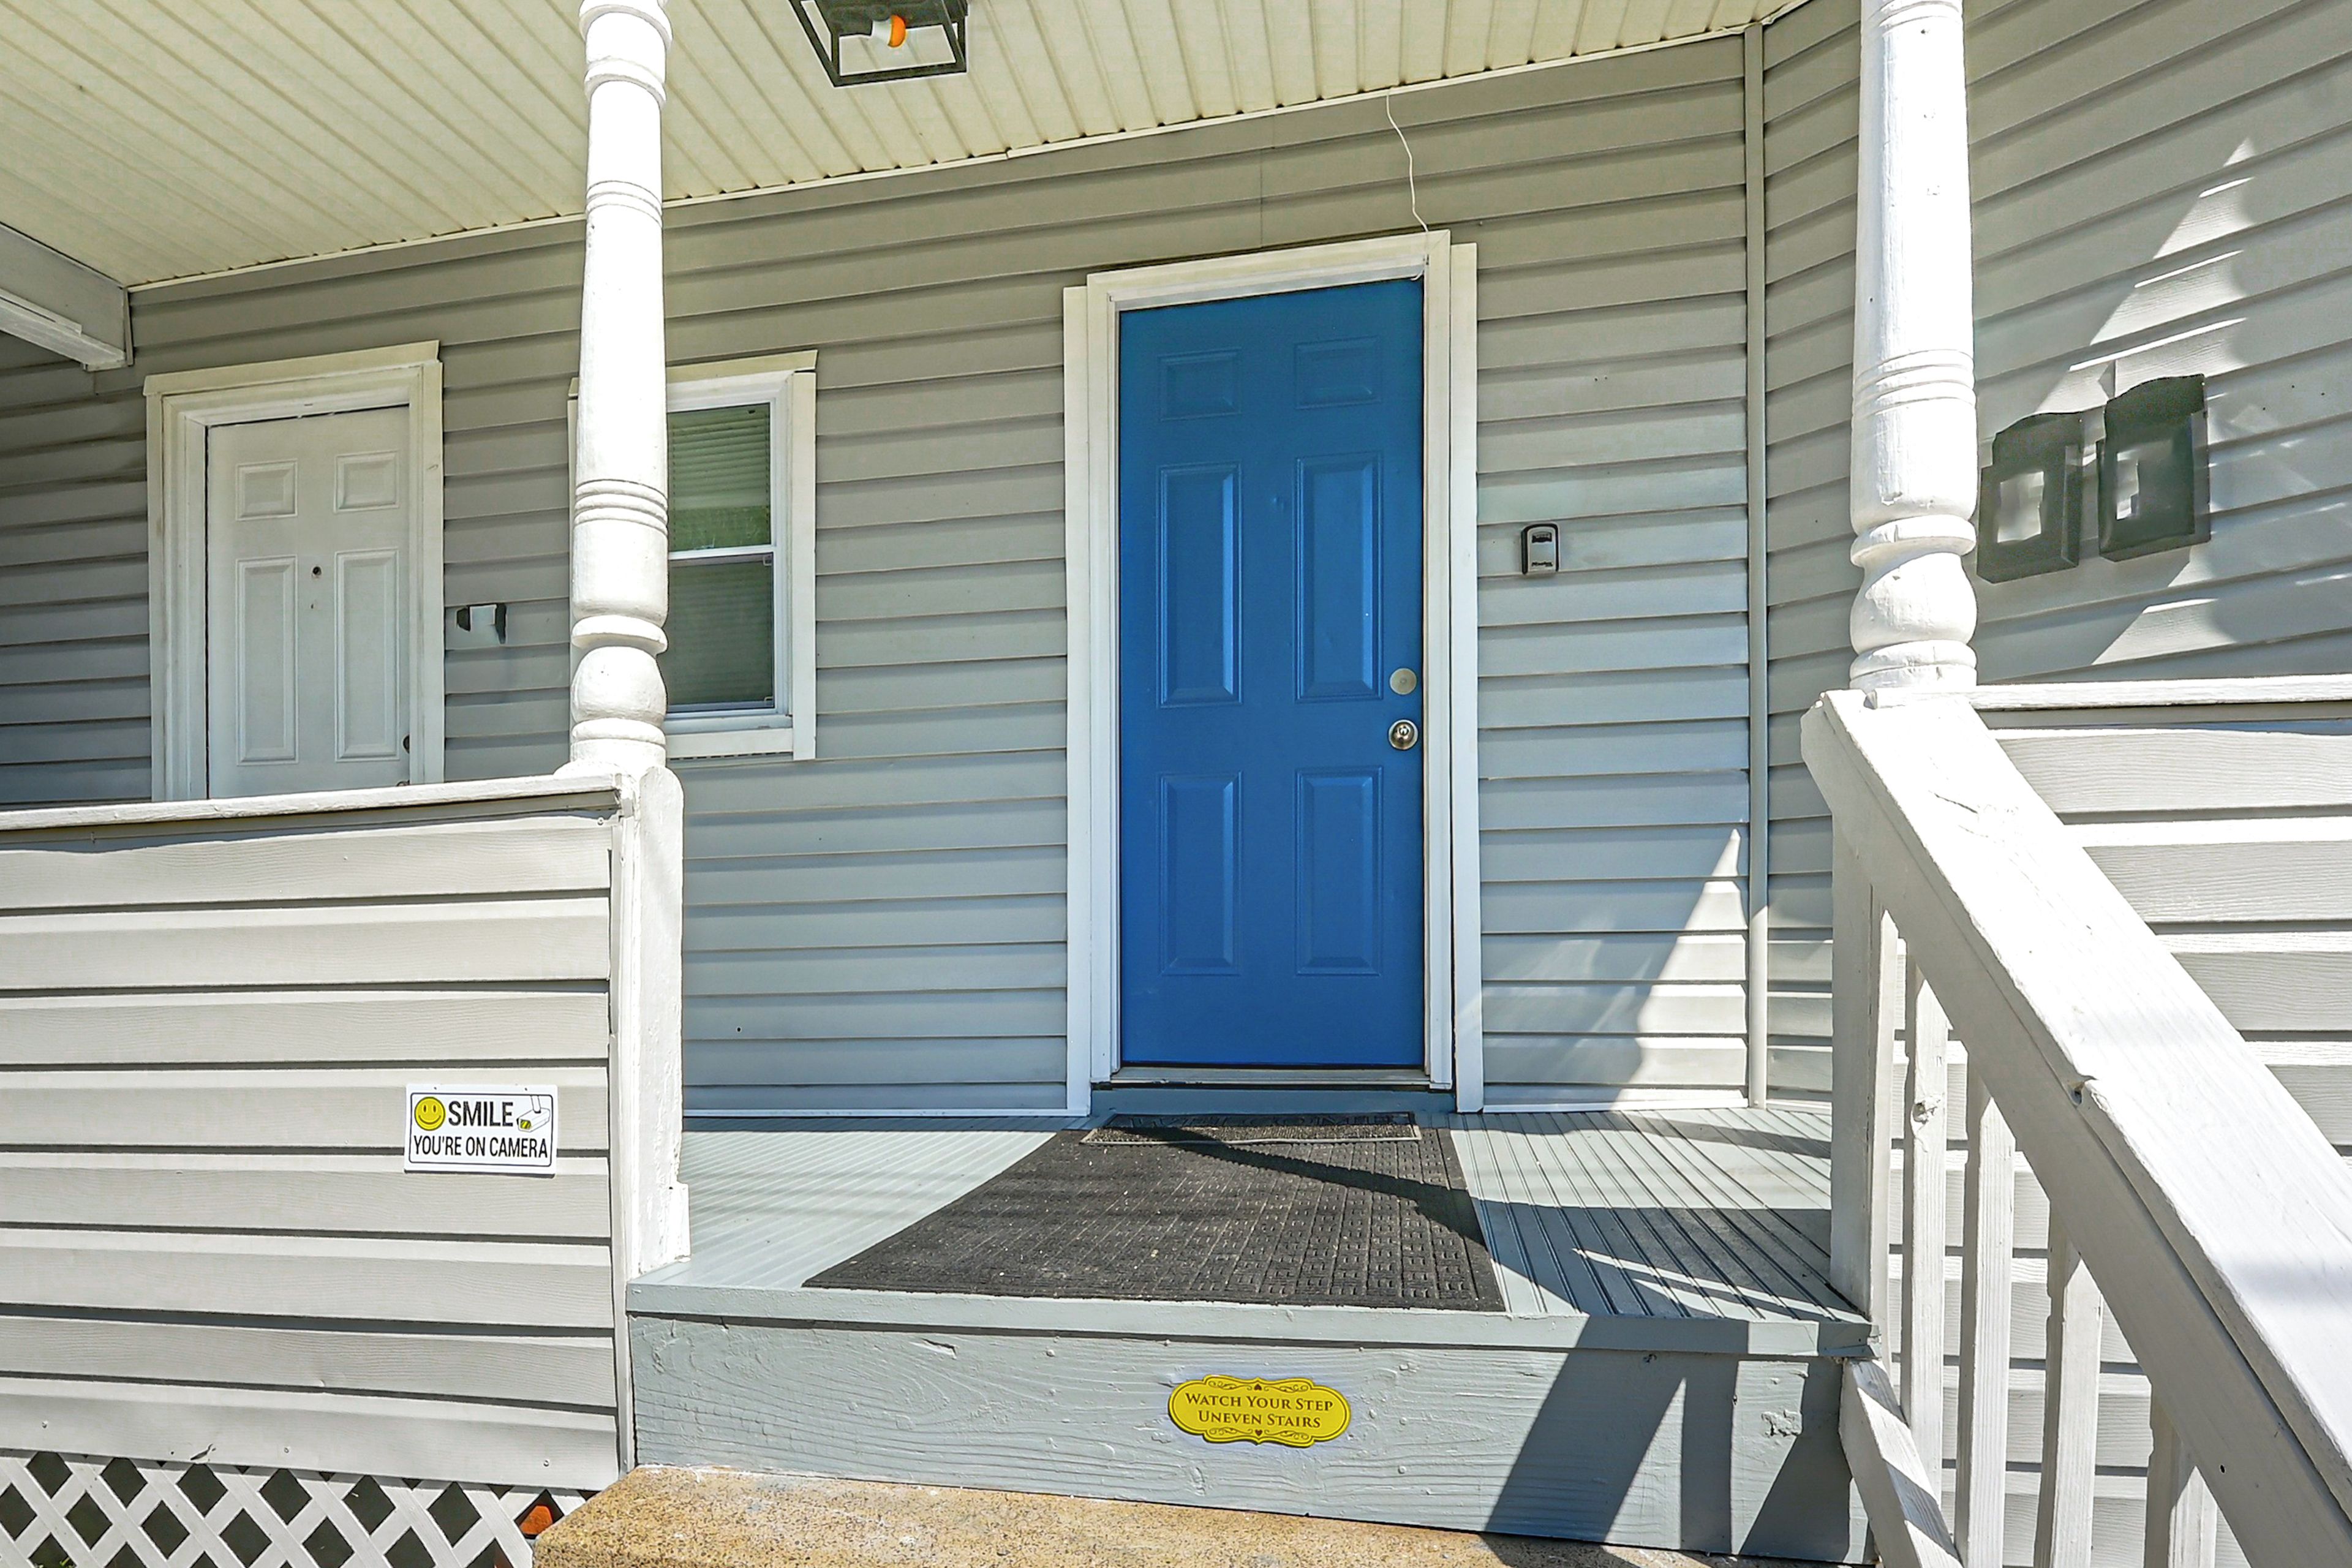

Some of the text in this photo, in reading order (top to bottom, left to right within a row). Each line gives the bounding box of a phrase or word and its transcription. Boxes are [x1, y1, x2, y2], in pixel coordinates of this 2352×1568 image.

[448, 1101, 513, 1127] SMILE
[413, 1135, 548, 1158] YOU'RE ON CAMERA
[1185, 1392, 1333, 1411] WATCH YOUR STEP
[1197, 1410, 1321, 1428] UNEVEN STAIRS
